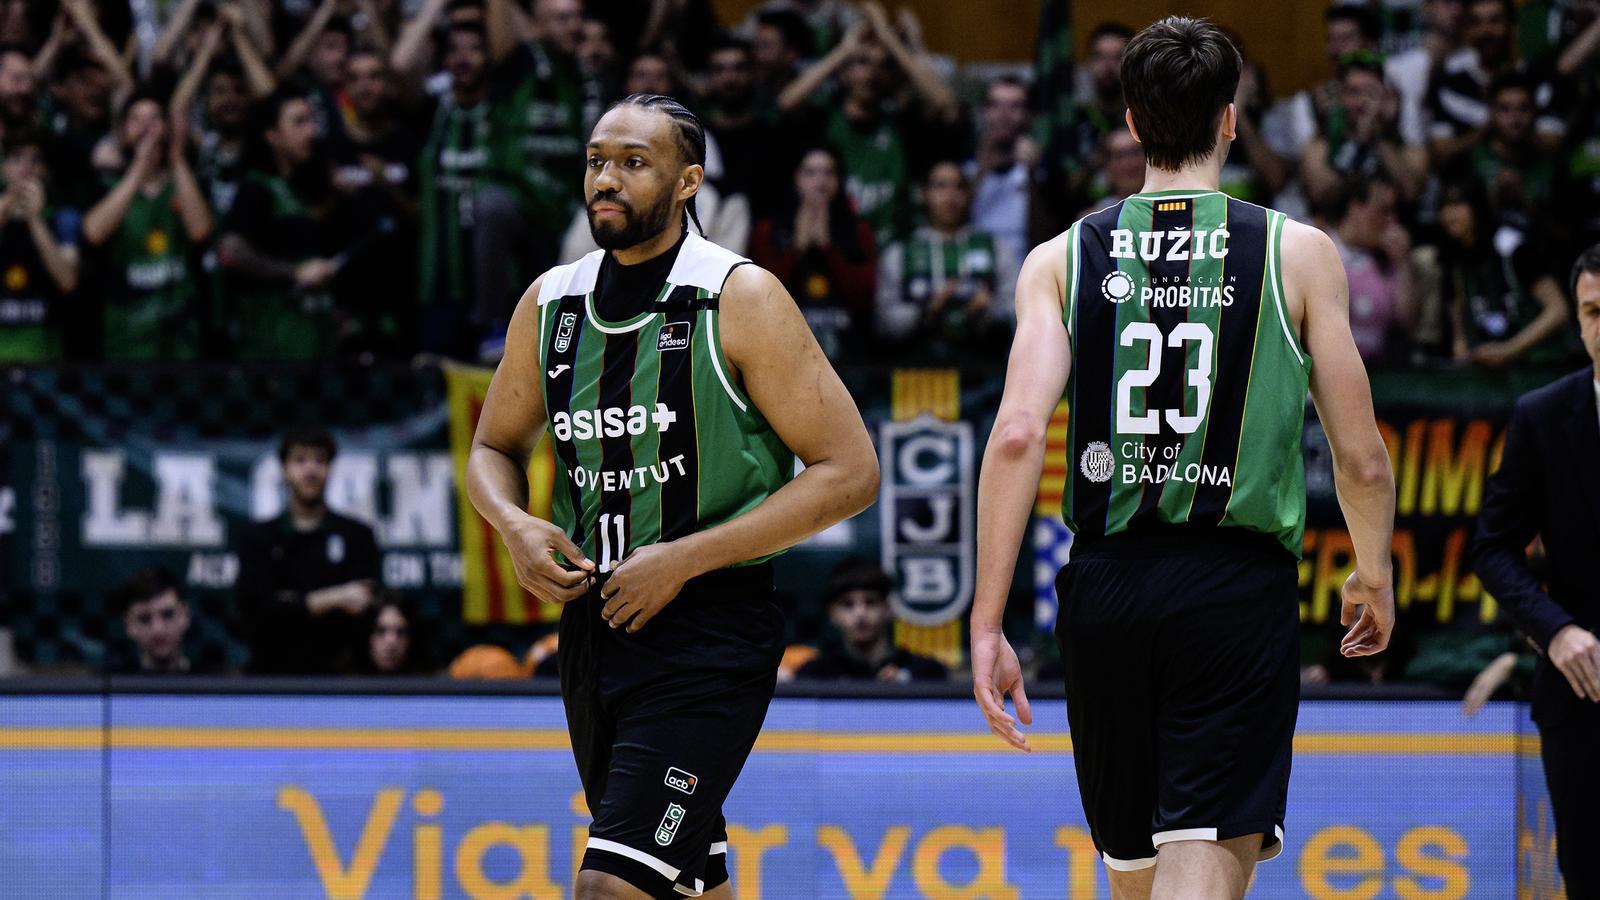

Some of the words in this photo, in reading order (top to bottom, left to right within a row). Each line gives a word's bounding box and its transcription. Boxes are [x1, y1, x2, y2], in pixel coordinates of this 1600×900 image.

[1109, 223, 1230, 261] RUŽIĆ
[1141, 274, 1237, 284] FUNDACIÓN
[1141, 285, 1235, 308] PROBITAS
[659, 338, 686, 348] endesa
[1117, 322, 1214, 434] 23
[1122, 442, 1156, 464] City
[1164, 443, 1181, 460] of
[568, 453, 687, 492] OVENTUT
[1123, 461, 1231, 487] BADLONA
[81, 449, 227, 548] LA
[599, 513, 625, 573] 11
[668, 776, 689, 789] acb
